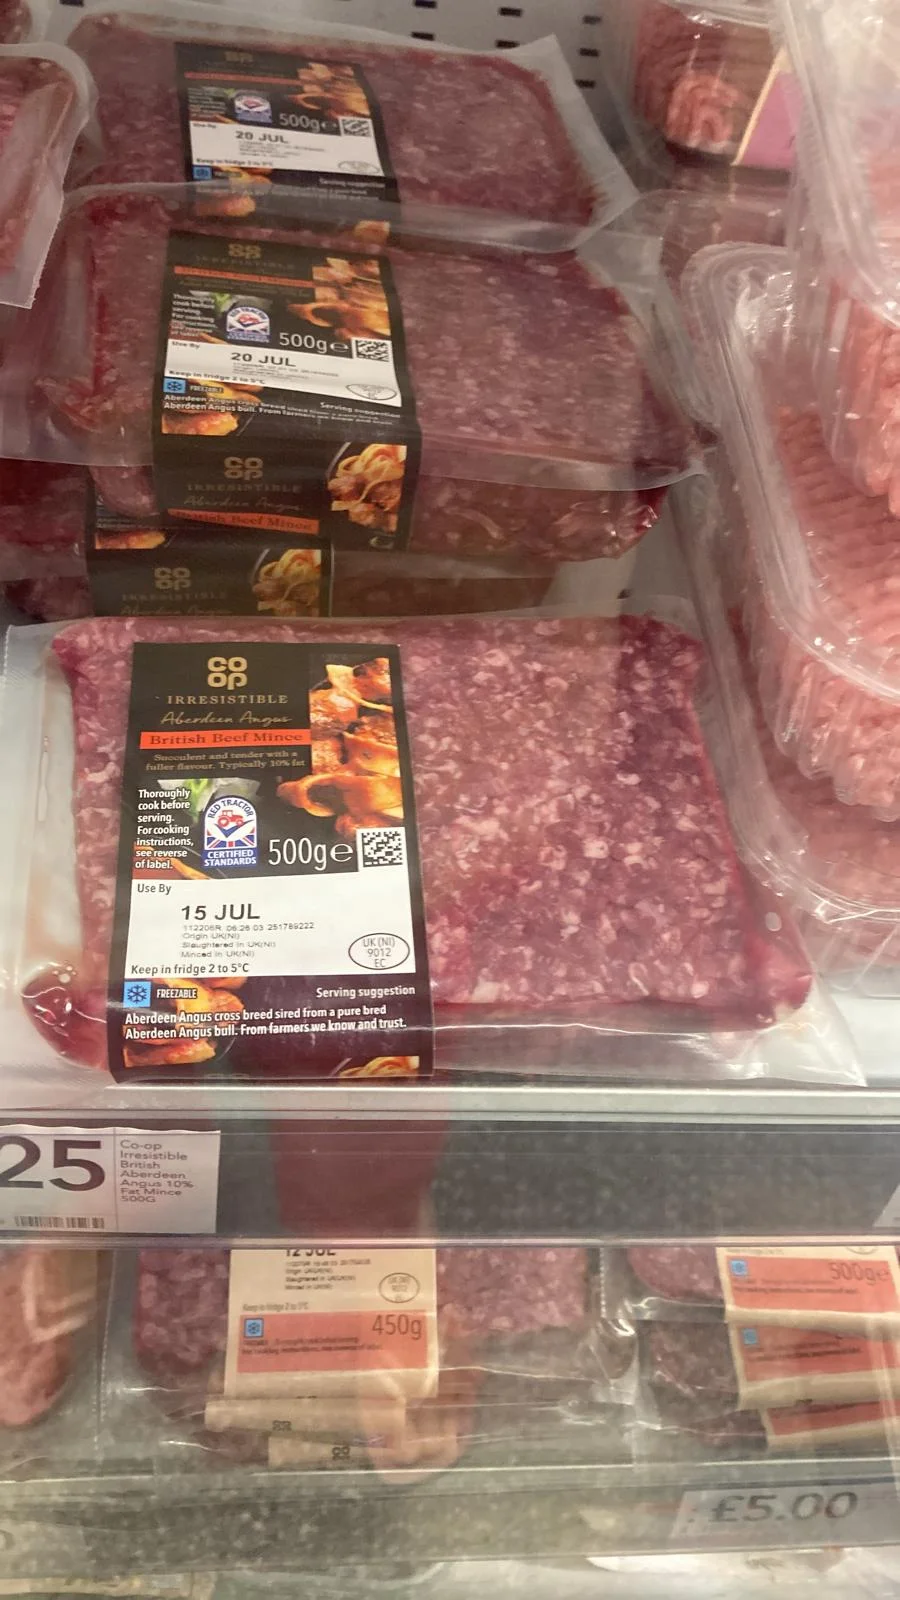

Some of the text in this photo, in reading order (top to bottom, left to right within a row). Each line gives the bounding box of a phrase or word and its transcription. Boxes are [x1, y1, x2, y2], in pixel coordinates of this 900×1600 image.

[235, 130, 289, 144] 20 JUL
[231, 352, 297, 367] 20 JUL
[164, 394, 207, 402] Aberdeen
[164, 402, 207, 410] Aberdeen
[208, 404, 236, 412] Angus
[259, 407, 281, 415] From
[167, 695, 289, 705] IRRESISTIBLE
[160, 710, 293, 728] Aberdeen Angus
[150, 732, 304, 746] British Beef Mince
[154, 753, 207, 762] Succulent
[209, 752, 228, 760] and
[230, 752, 263, 760] tender
[266, 750, 289, 758] with
[146, 763, 174, 771] fuller
[177, 762, 216, 771] flavour.
[219, 761, 266, 770] Typically
[292, 759, 305, 767] fat
[139, 788, 190, 799] Thoroughly
[138, 800, 190, 811] cook before
[207, 799, 254, 819] RED TRACTOR
[137, 813, 175, 824] serving.
[137, 825, 190, 836] For cooking
[136, 837, 194, 848] instructions,
[135, 849, 188, 858] see reverse
[207, 850, 254, 859] CERTIFIED
[135, 860, 173, 870] of label.
[204, 857, 257, 867] STANDARDS
[137, 883, 172, 895] Use By
[181, 903, 260, 920] 15 JUL
[182, 932, 208, 941] Origin
[368, 948, 391, 957] 9012
[374, 958, 386, 968] EC
[131, 963, 249, 977] Keep in fridge 2 to 5°C
[156, 988, 197, 999] FREEZABLE
[316, 985, 415, 999] Serving suggestion
[125, 1013, 177, 1024] Aberdeen
[179, 1011, 212, 1025] Angus
[214, 1012, 240, 1021] cross
[243, 1009, 273, 1020] breed
[275, 1008, 300, 1019] sired
[302, 1007, 327, 1018] from
[337, 1007, 361, 1019] pure
[363, 1005, 387, 1015] bred
[125, 1018, 407, 1040] Aberdeen Angus bull. From farmers we know and trust.
[120, 1139, 162, 1151] Co-op
[120, 1151, 188, 1160] Irresistible
[120, 1160, 160, 1169] British
[120, 1170, 186, 1179] Aberdeen
[120, 1180, 194, 1188] Angus 10%
[144, 1188, 182, 1196] Mince
[120, 1195, 156, 1203] 500G
[372, 1313, 422, 1340] 450g
[711, 1491, 858, 1524] £5.00
